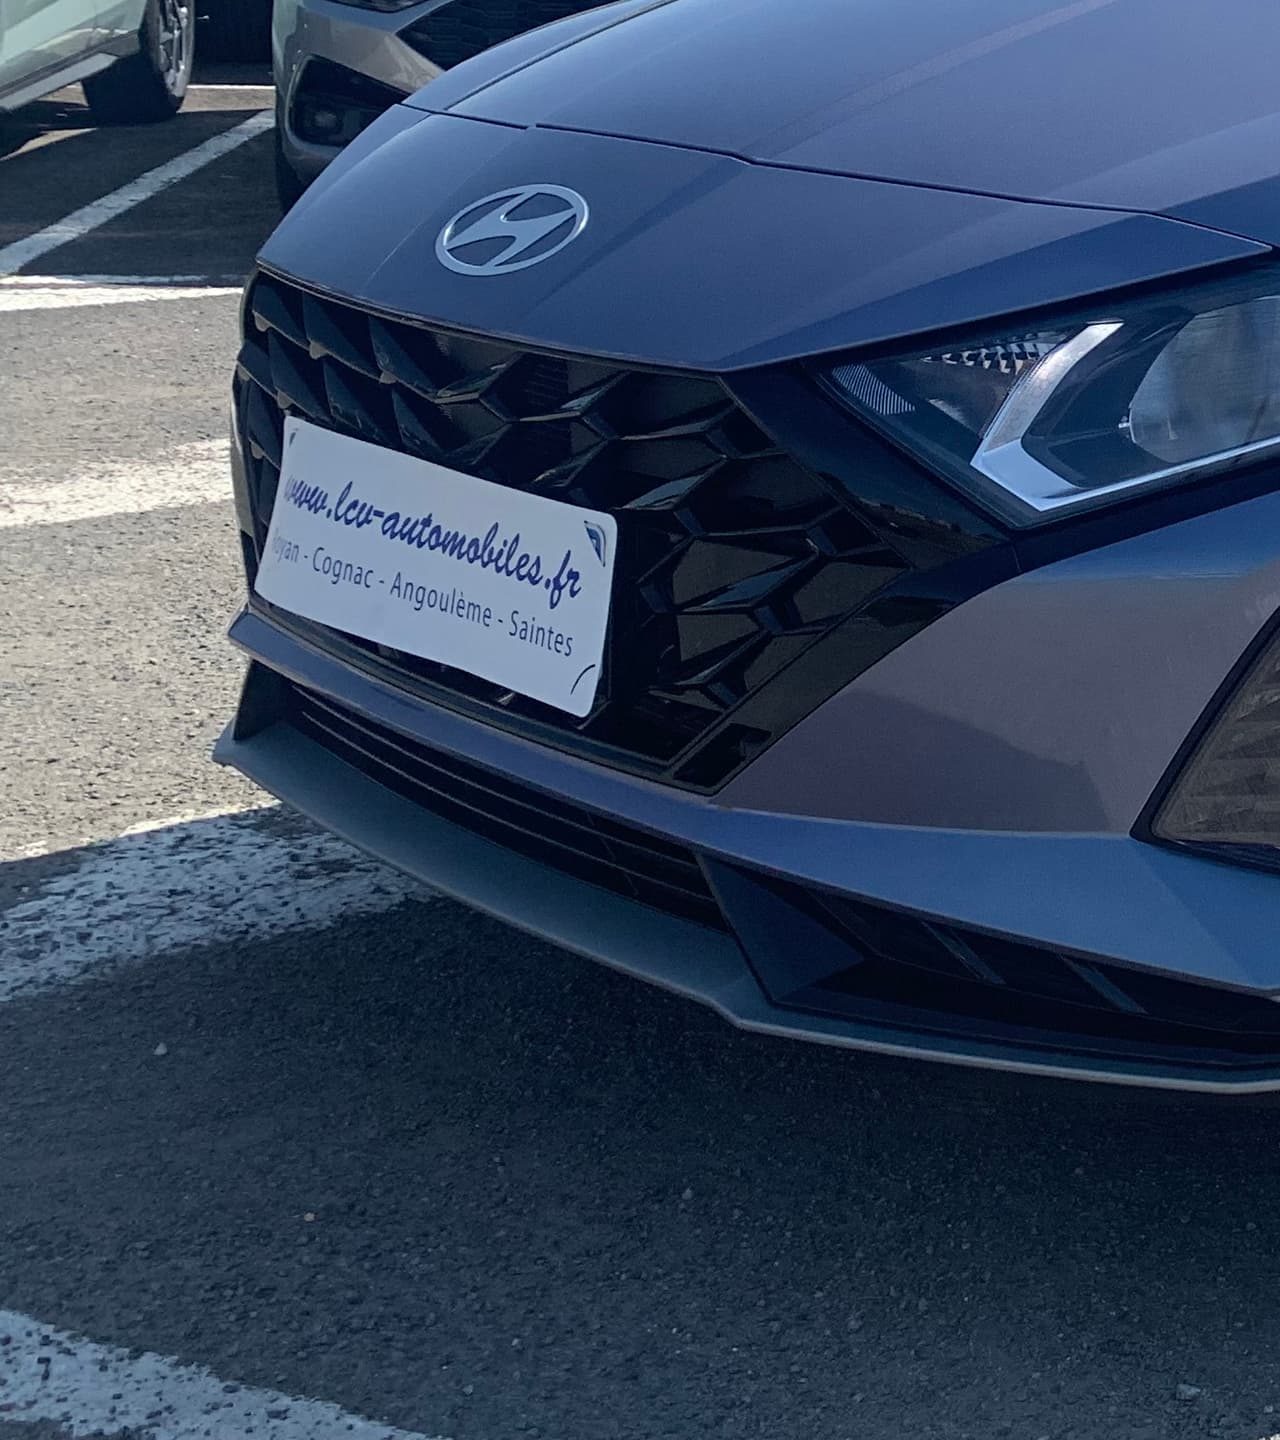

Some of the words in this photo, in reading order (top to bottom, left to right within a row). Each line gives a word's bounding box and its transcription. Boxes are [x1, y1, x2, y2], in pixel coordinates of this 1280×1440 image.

[284, 474, 583, 609] www.lcv-automobiles.fr
[313, 546, 374, 589] Cognac
[508, 610, 574, 657] Saintes
